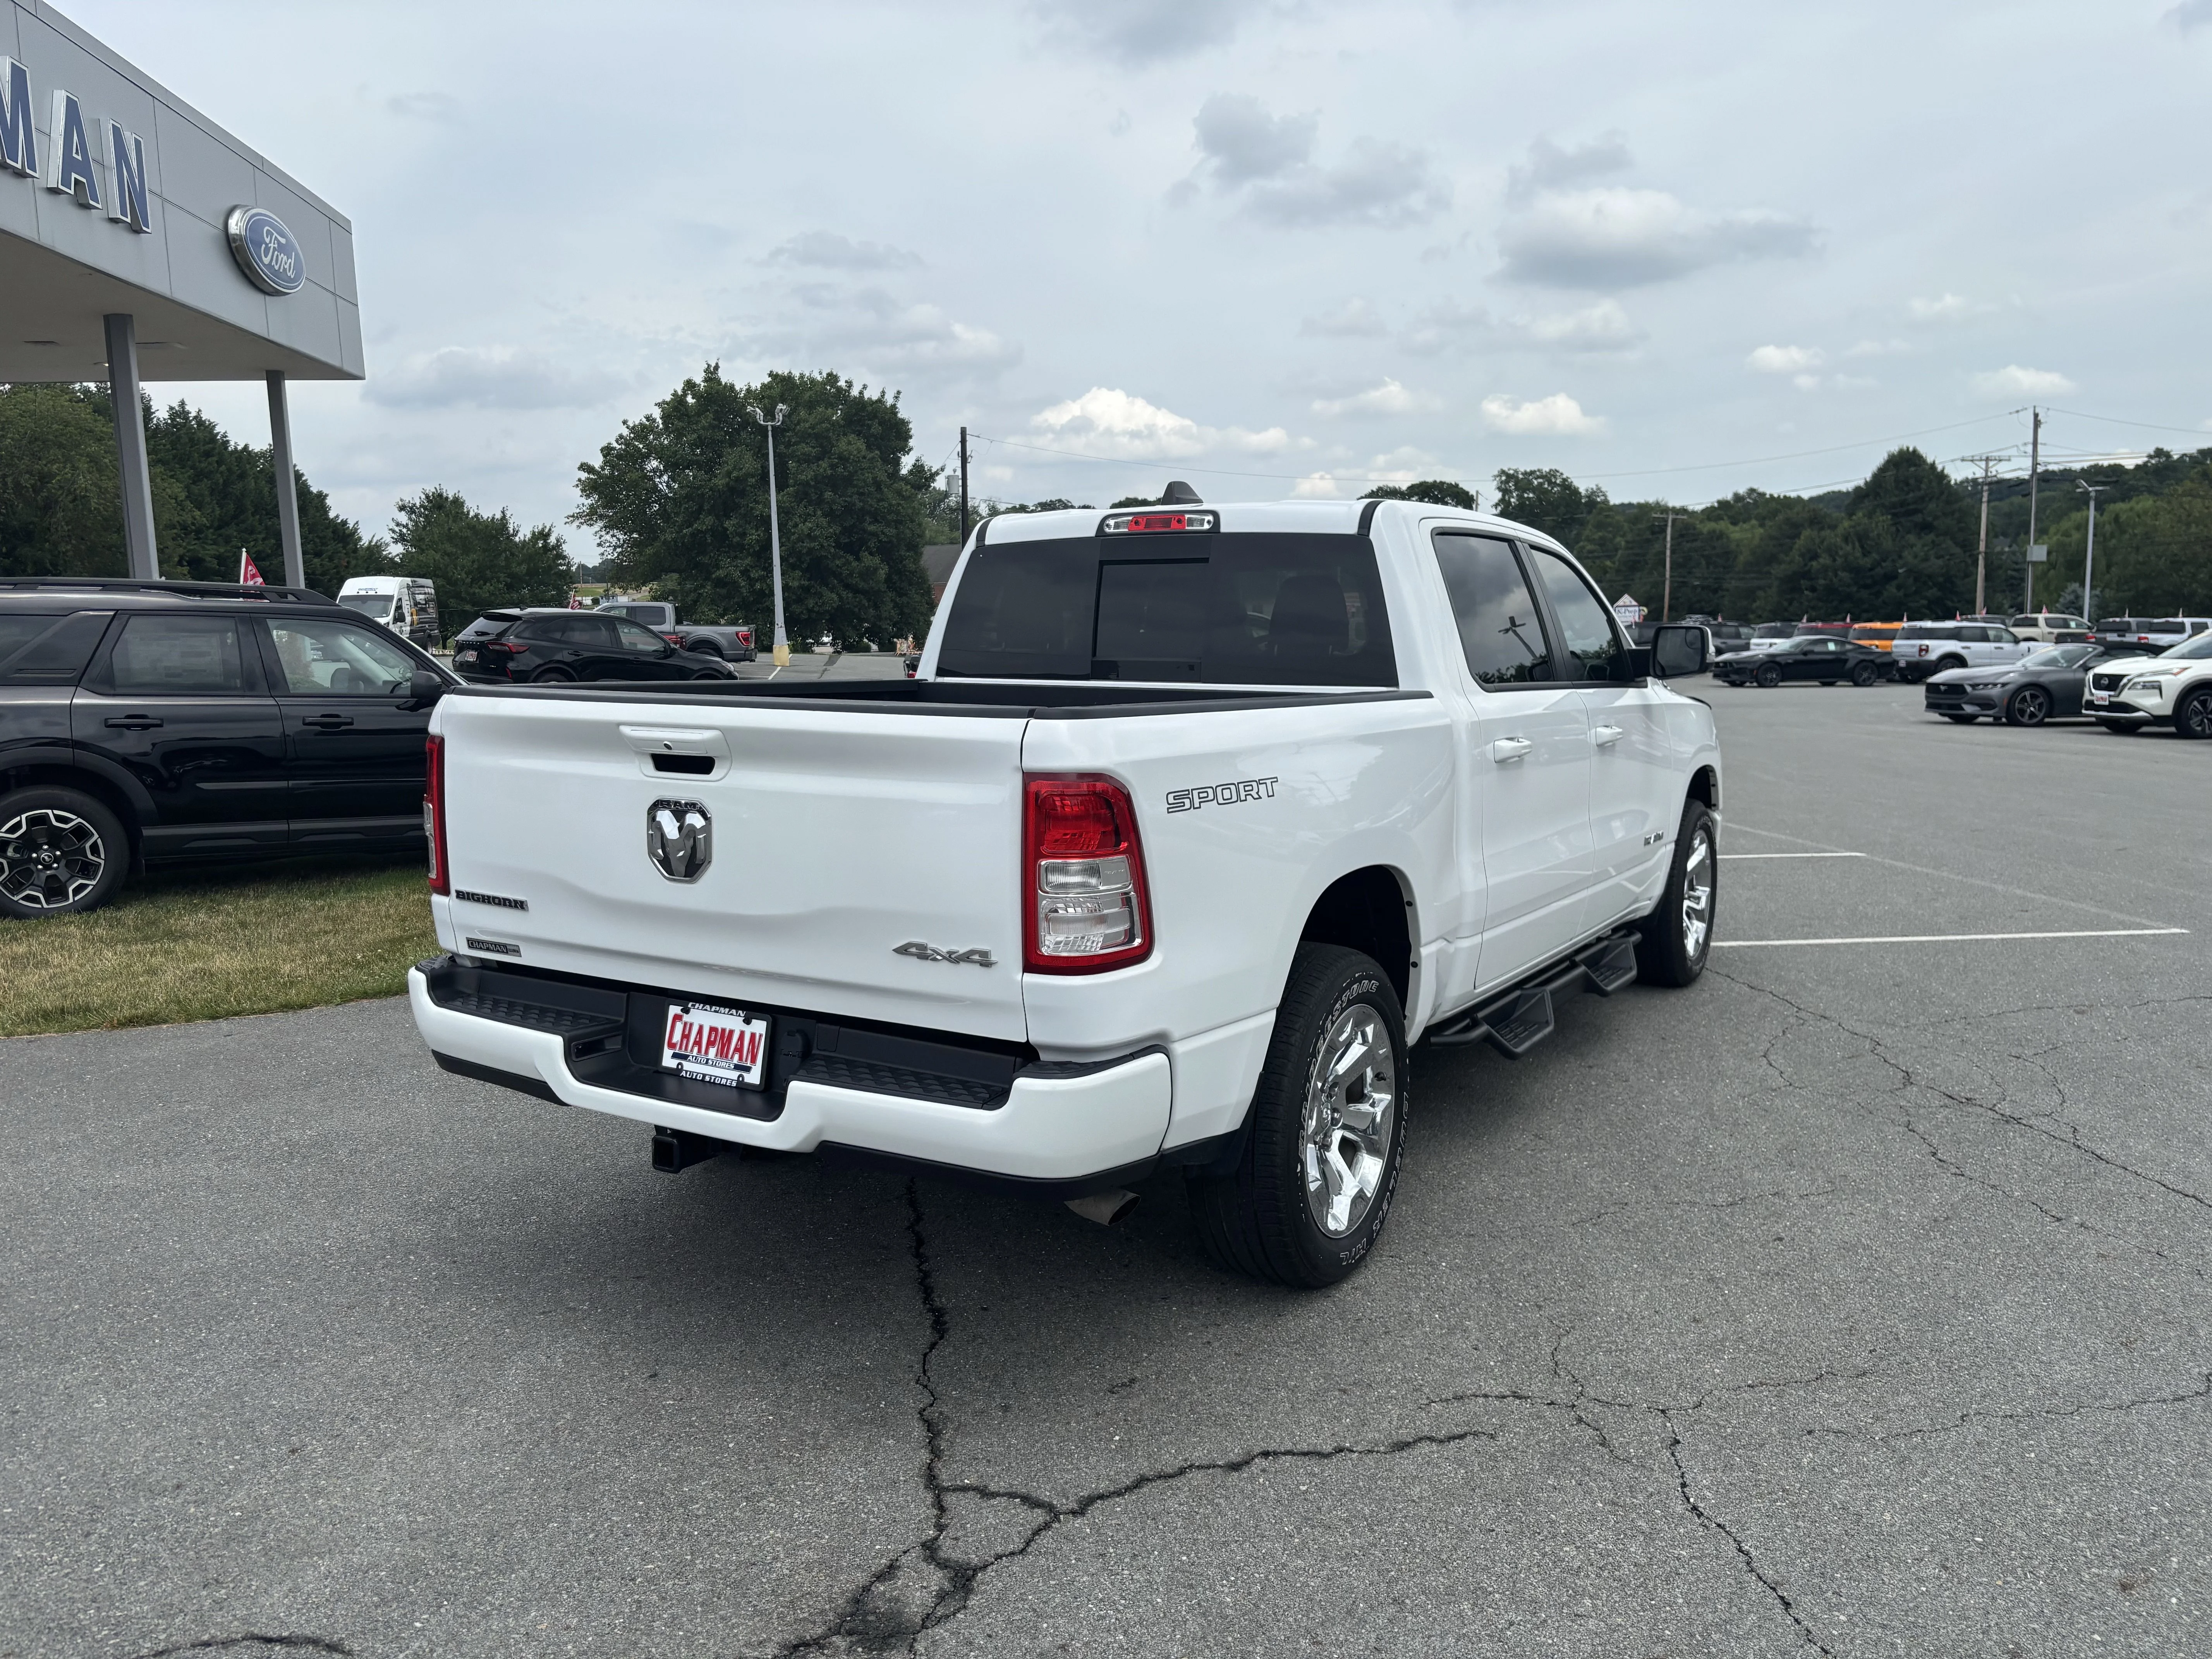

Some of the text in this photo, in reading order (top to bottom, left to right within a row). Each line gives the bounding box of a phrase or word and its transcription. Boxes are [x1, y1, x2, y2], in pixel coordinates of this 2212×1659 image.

[261, 227, 295, 278] Ford
[1166, 776, 1278, 814] SPORT
[658, 800, 698, 811] RAM
[455, 890, 526, 910] BIGHORN
[469, 940, 507, 953] CHAPMAN
[688, 1002, 746, 1017] CHAPMAN
[667, 1013, 763, 1066] CHAPMAN
[687, 1055, 735, 1069] AUTO STORES
[680, 1071, 737, 1087] AUTO STORES
